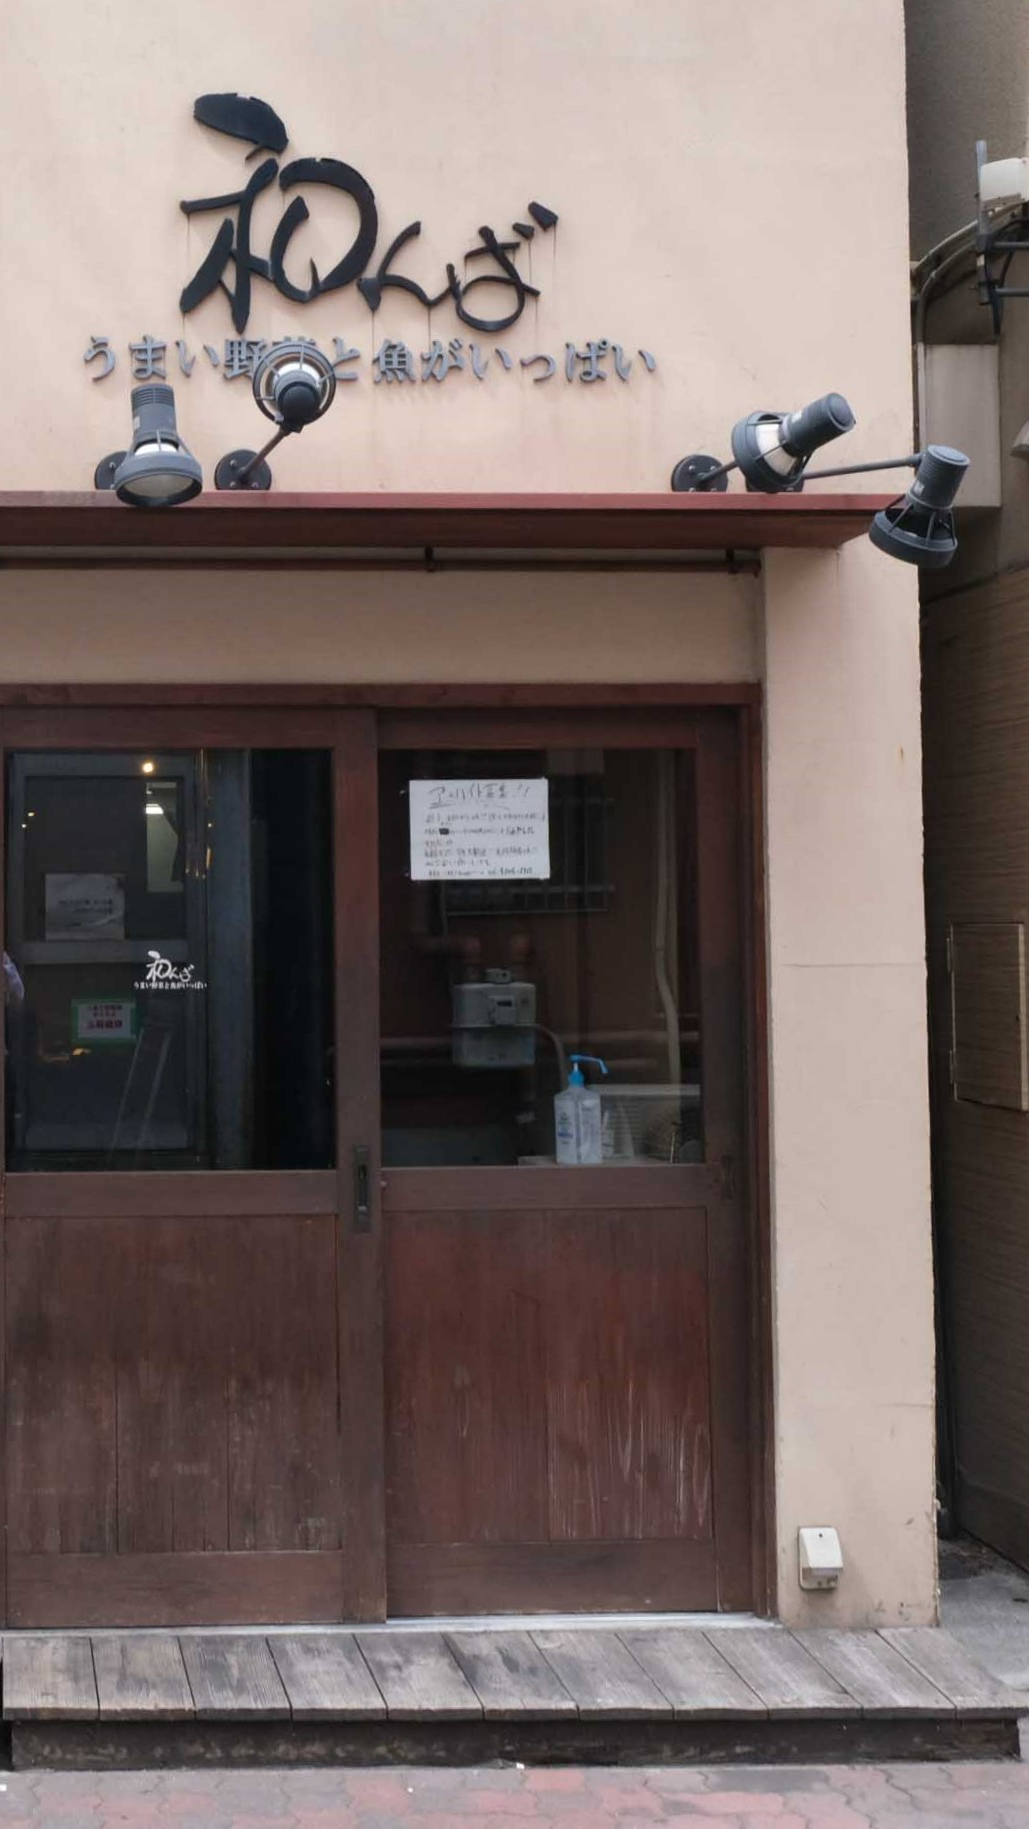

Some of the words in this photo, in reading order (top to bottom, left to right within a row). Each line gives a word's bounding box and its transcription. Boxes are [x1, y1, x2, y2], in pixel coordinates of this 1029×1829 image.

[82, 334, 657, 383] うまい野と魚がいっぱい
